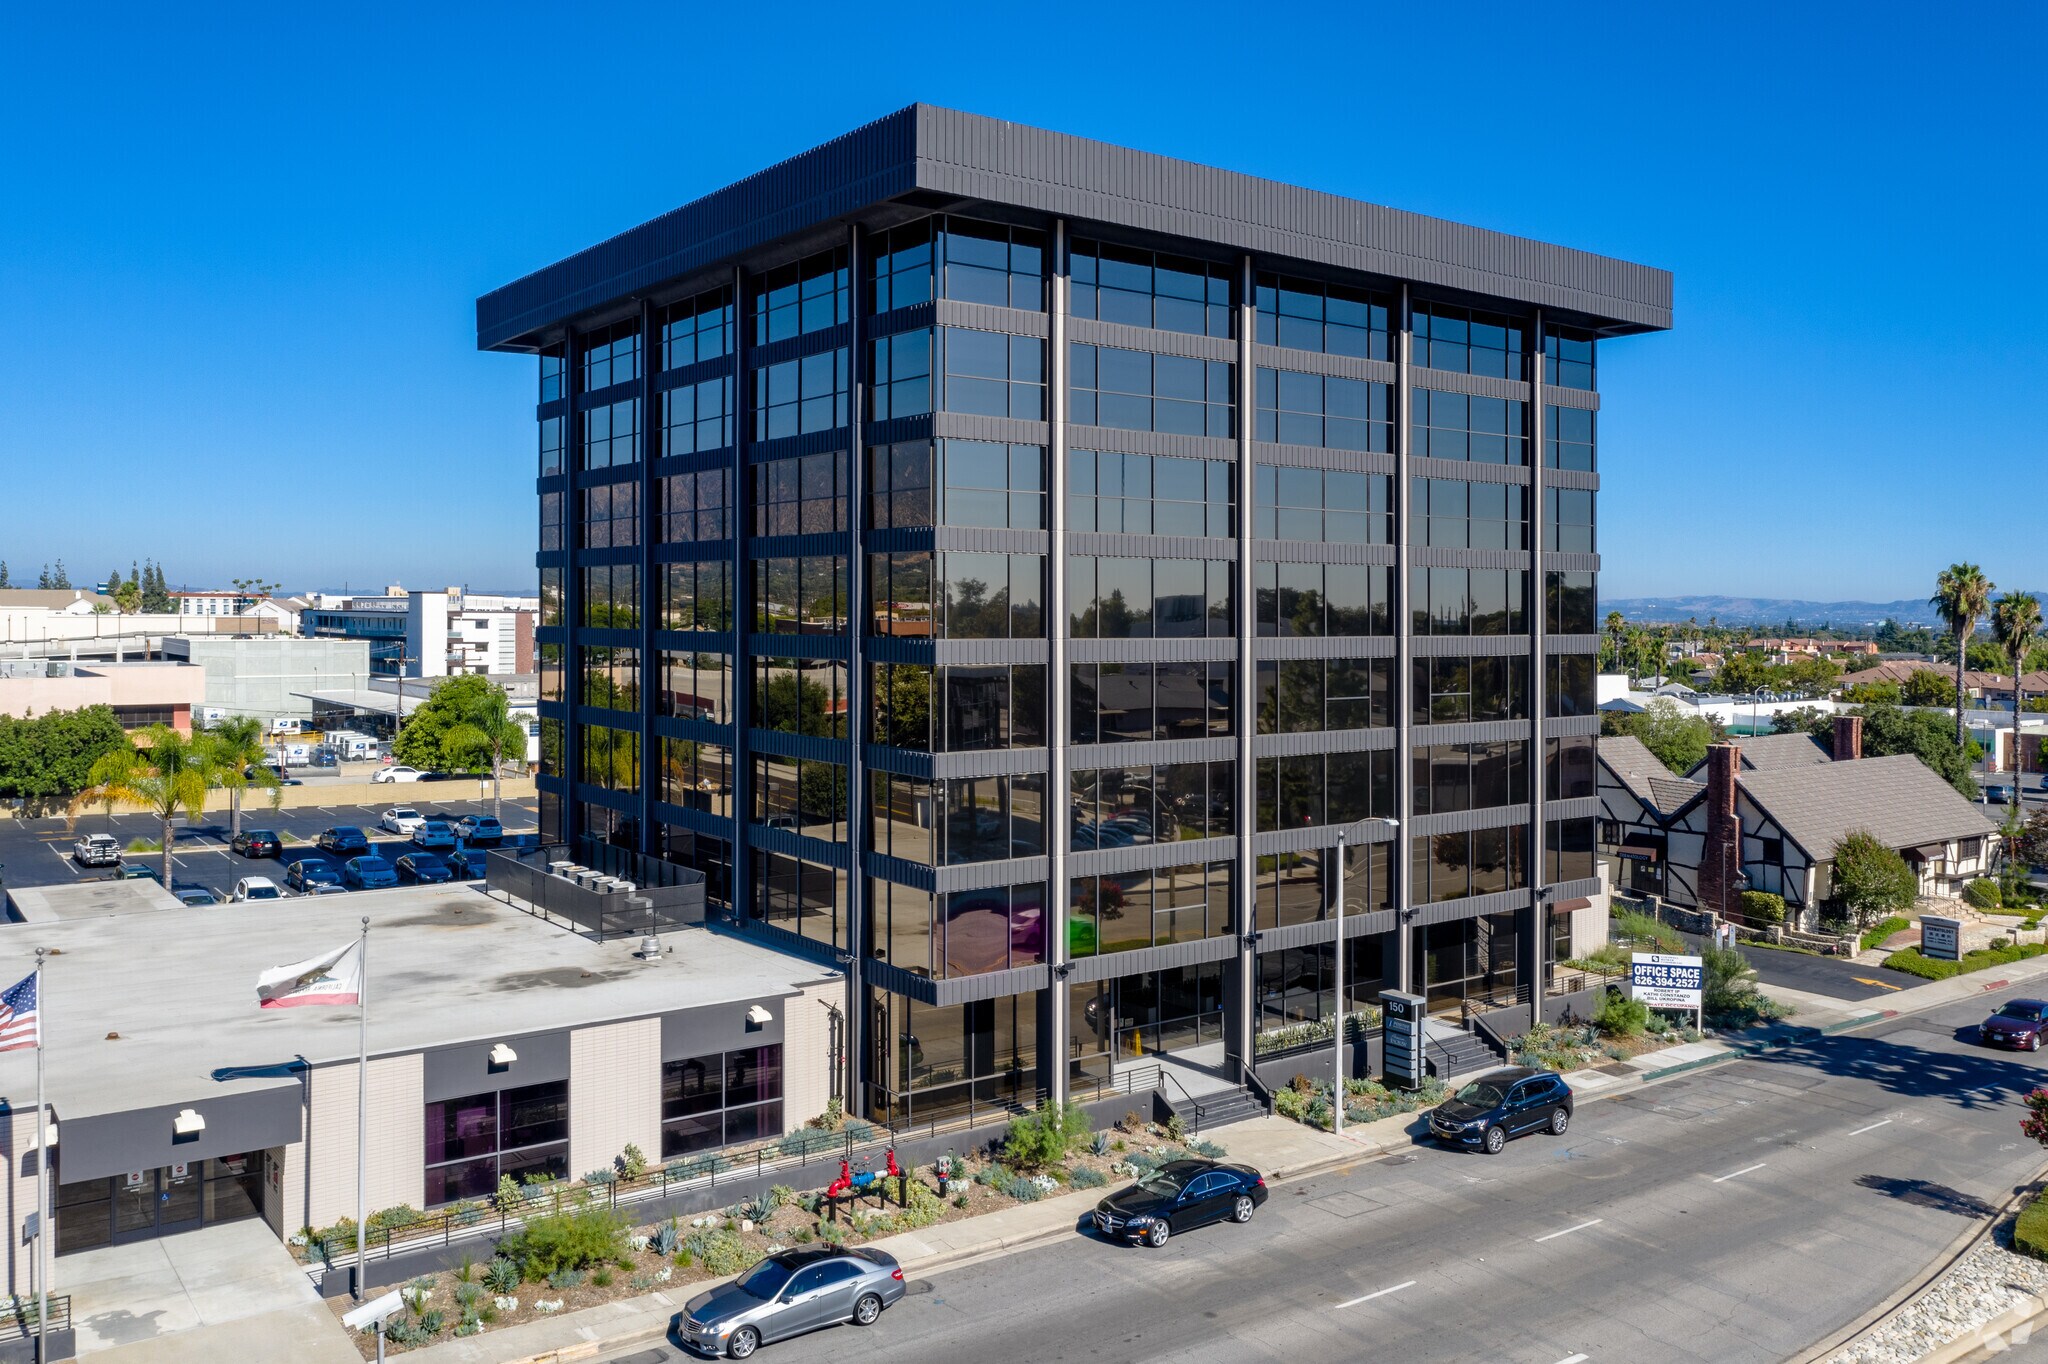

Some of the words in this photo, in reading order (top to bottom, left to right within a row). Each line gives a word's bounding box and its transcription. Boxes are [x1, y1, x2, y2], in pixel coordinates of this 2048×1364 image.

[1634, 965, 1668, 977] OFFICE
[1670, 968, 1700, 979] SPACE
[1634, 976, 1699, 987] 626-394-2527
[1389, 1001, 1404, 1013] 150
